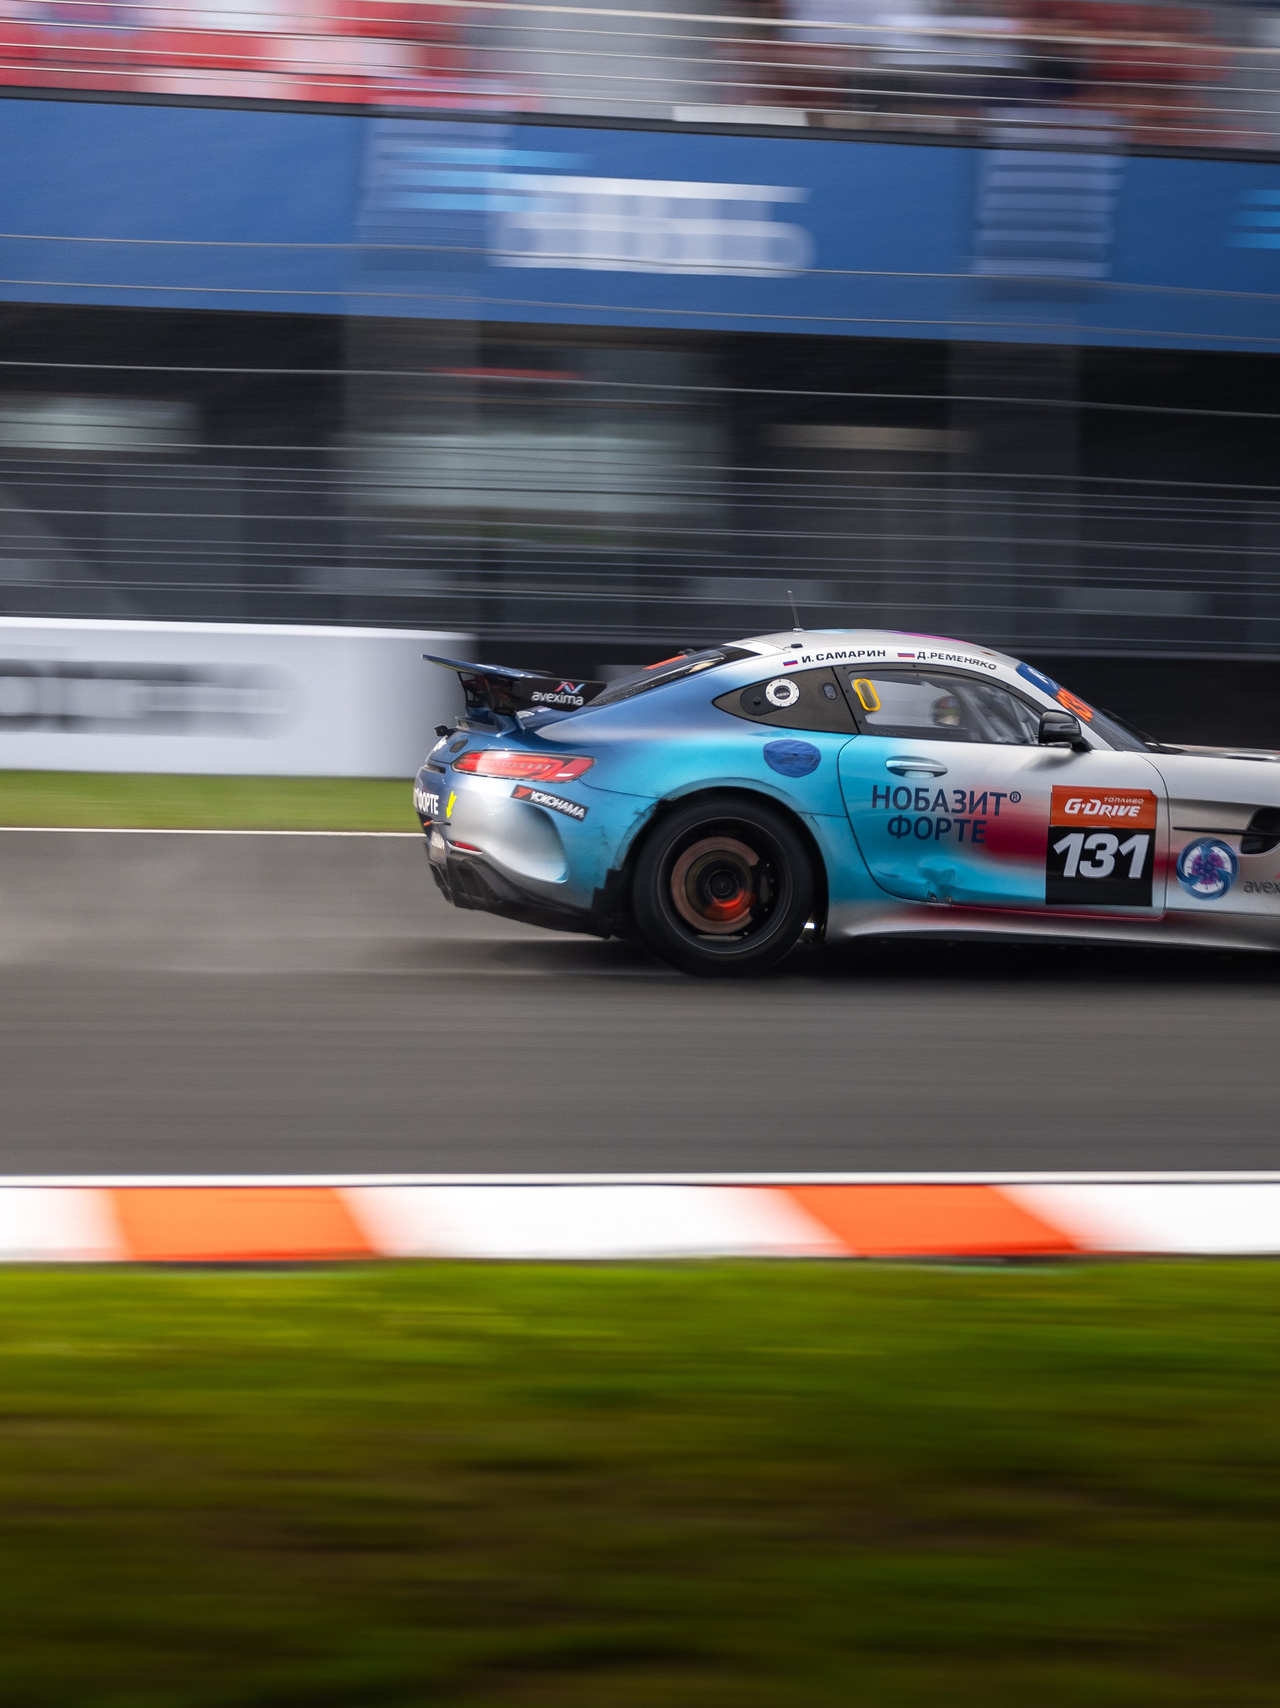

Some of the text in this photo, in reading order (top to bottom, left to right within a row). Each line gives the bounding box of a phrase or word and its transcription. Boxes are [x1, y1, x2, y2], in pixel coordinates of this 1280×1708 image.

[531, 688, 584, 706] avexima
[530, 790, 586, 819] YOKOHAMA
[887, 814, 987, 844] ФОРТЕ
[1053, 832, 1150, 879] 131
